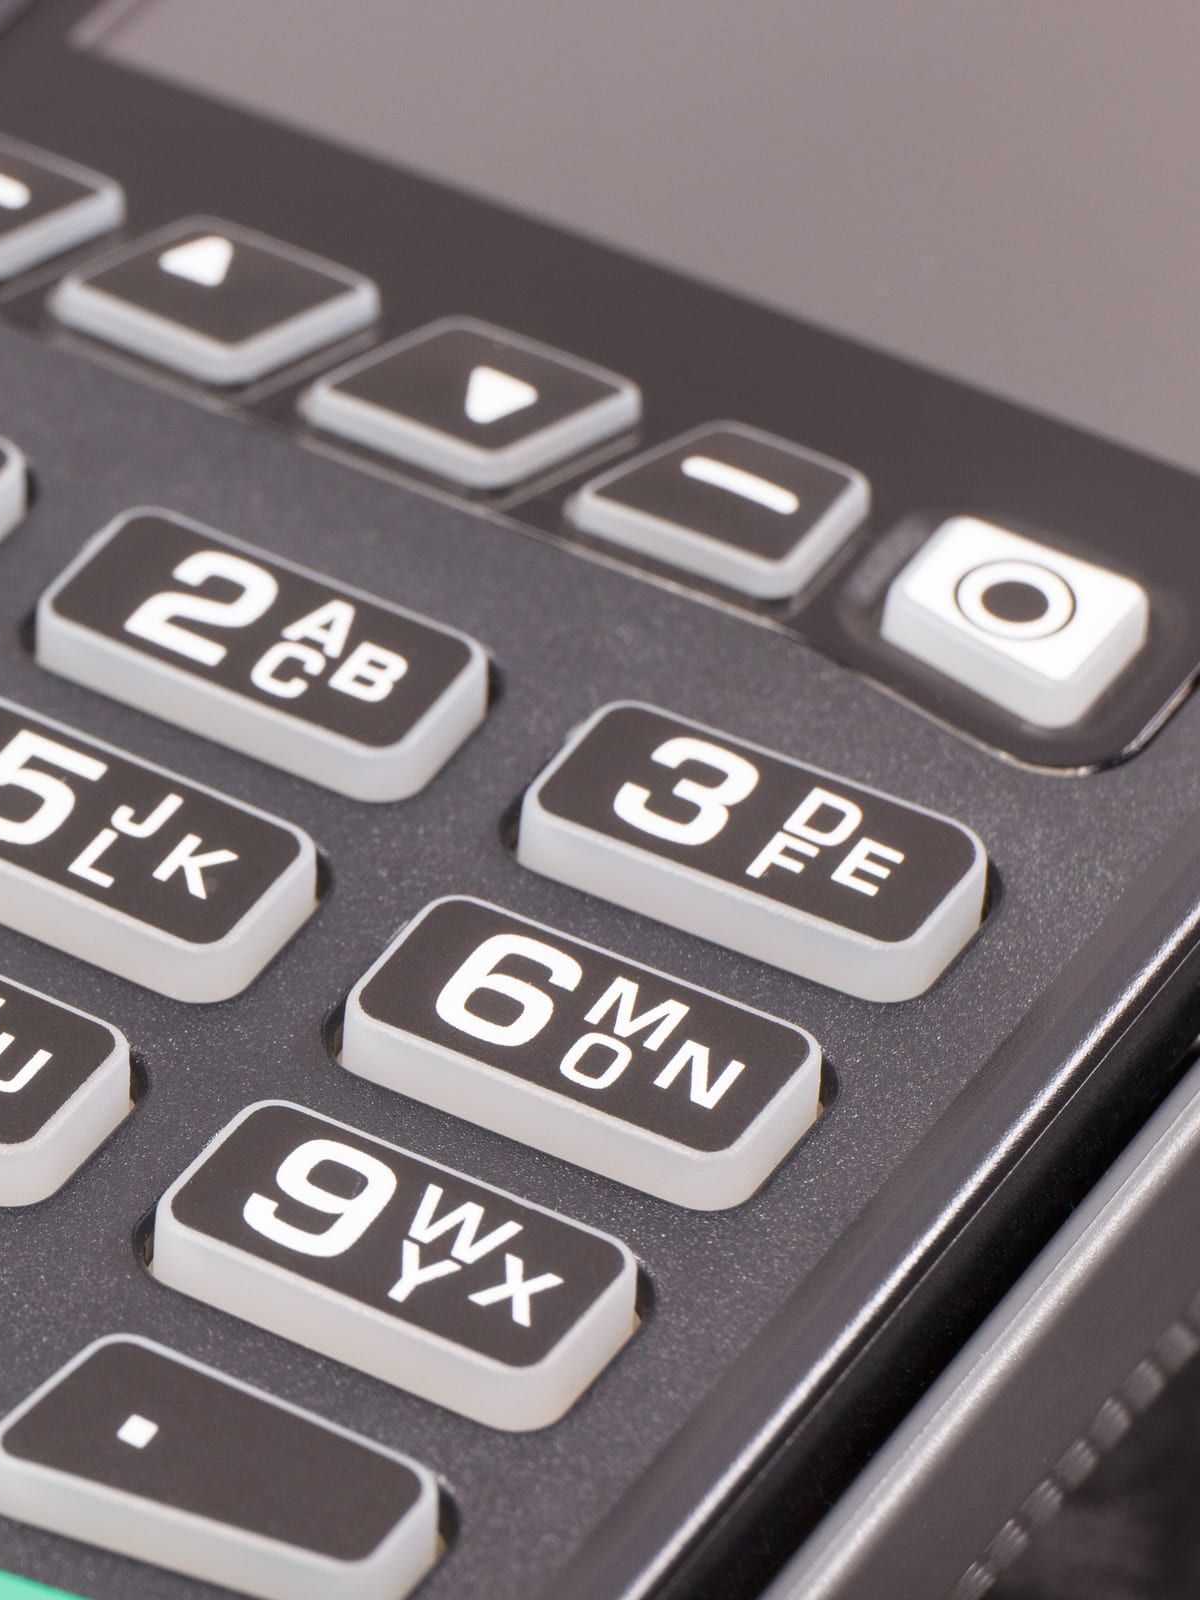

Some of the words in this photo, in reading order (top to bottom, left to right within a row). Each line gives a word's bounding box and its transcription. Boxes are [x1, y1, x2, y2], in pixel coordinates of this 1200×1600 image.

[125, 552, 277, 666] 2
[614, 738, 758, 845] 3
[436, 934, 582, 1046] 6
[243, 1139, 397, 1257] 9
